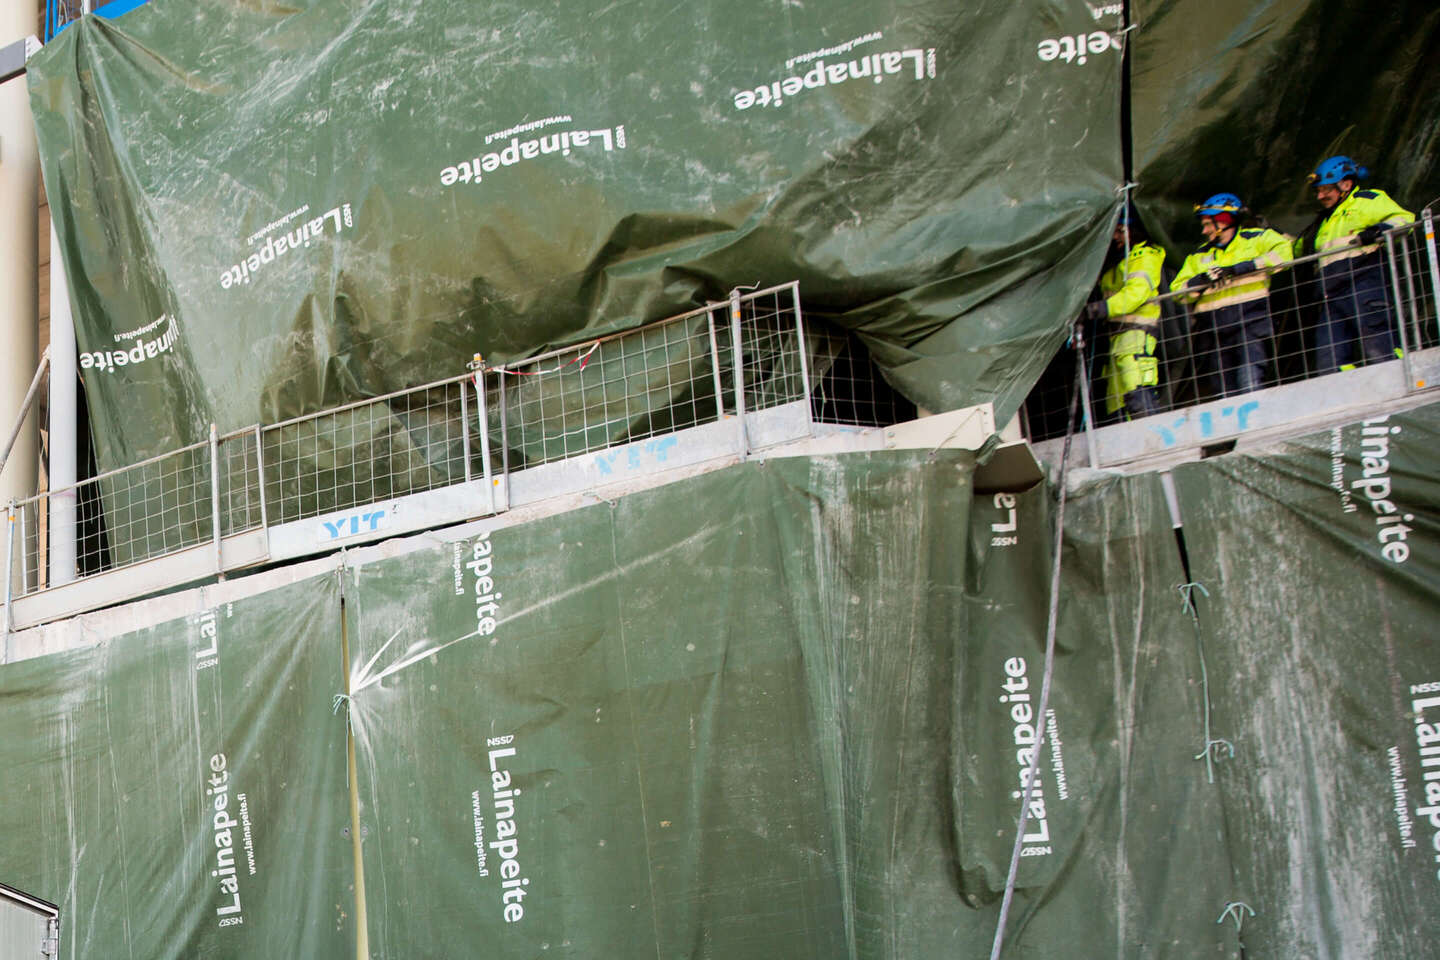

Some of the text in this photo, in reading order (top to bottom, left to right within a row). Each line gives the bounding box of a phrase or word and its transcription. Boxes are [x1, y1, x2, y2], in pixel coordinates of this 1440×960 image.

[734, 48, 924, 110] Lainapeite
[440, 128, 613, 186] Lainapeite
[220, 207, 342, 289] Lainapeite
[594, 435, 678, 475] YIT
[1147, 400, 1259, 447] YIT
[322, 510, 385, 539] YIT
[1352, 414, 1415, 564] inapeite
[194, 611, 218, 658] Lai
[999, 656, 1050, 843] Lainapeite
[1046, 708, 1069, 800] www.lainapeite.fi
[206, 753, 242, 916] Lainapeite
[237, 793, 257, 876] www.lainapeite.fi
[472, 790, 489, 877] www.lainapeite.fi
[488, 747, 530, 923] Lainapeite
[1388, 746, 1416, 848] www.lainapeite.fi
